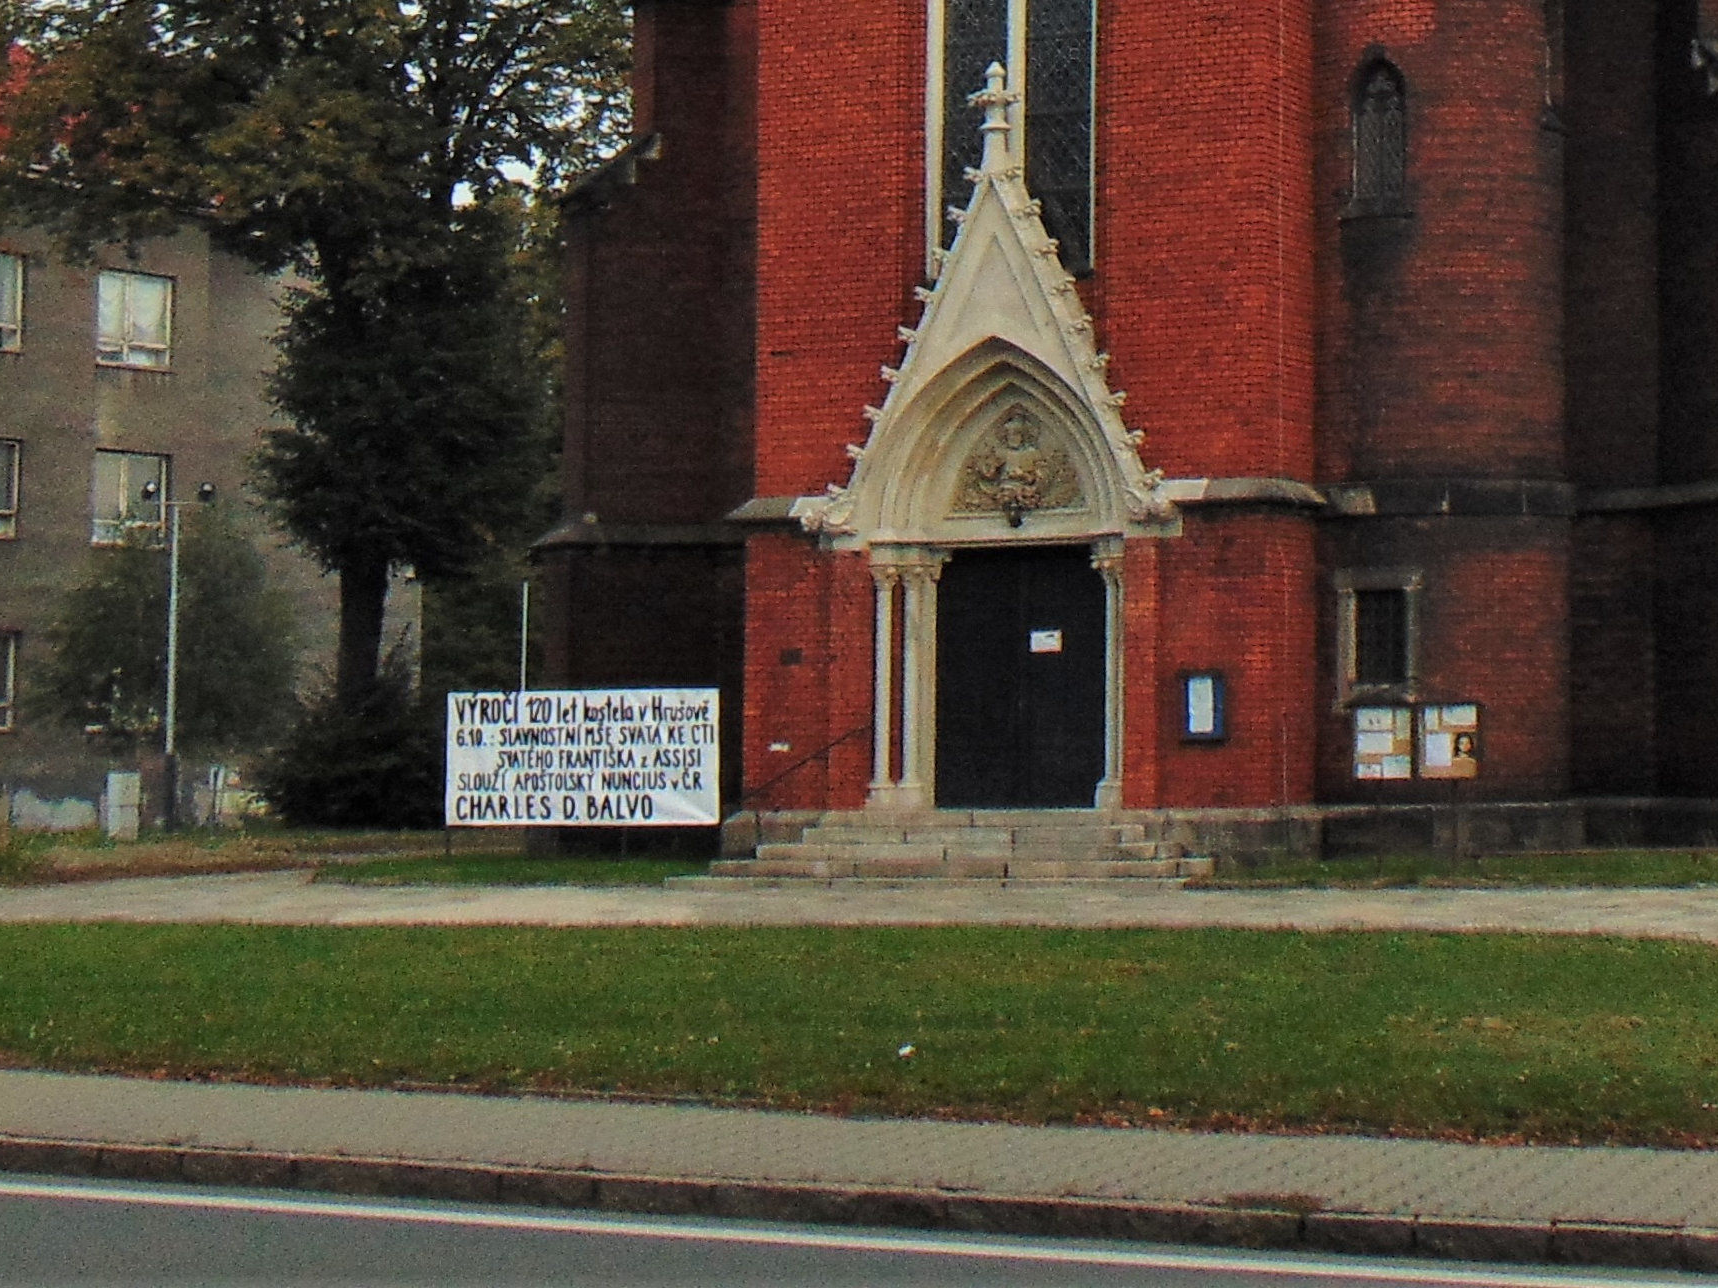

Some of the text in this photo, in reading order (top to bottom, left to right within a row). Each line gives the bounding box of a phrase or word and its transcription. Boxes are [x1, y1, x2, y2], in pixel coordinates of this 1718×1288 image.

[454, 691, 710, 725] VÝROČÍ 120 let kostela v Hrušově
[498, 723, 582, 747] SLAVNOSTNÍ
[585, 722, 612, 746] MŠE
[618, 721, 662, 745] SVATÁ
[667, 726, 685, 745] KE
[691, 724, 715, 745] CTI
[496, 746, 554, 769] SVATÉHO
[558, 746, 636, 769] FRANTIŠKA
[653, 748, 702, 768] ASSISI
[457, 768, 508, 792] SLOUŽÍ
[513, 768, 594, 792] APOŠTOLSKÝ
[601, 770, 667, 791] NUNCIUS
[682, 768, 703, 791] ČR
[456, 794, 654, 821] CHARLES D. BALVO
